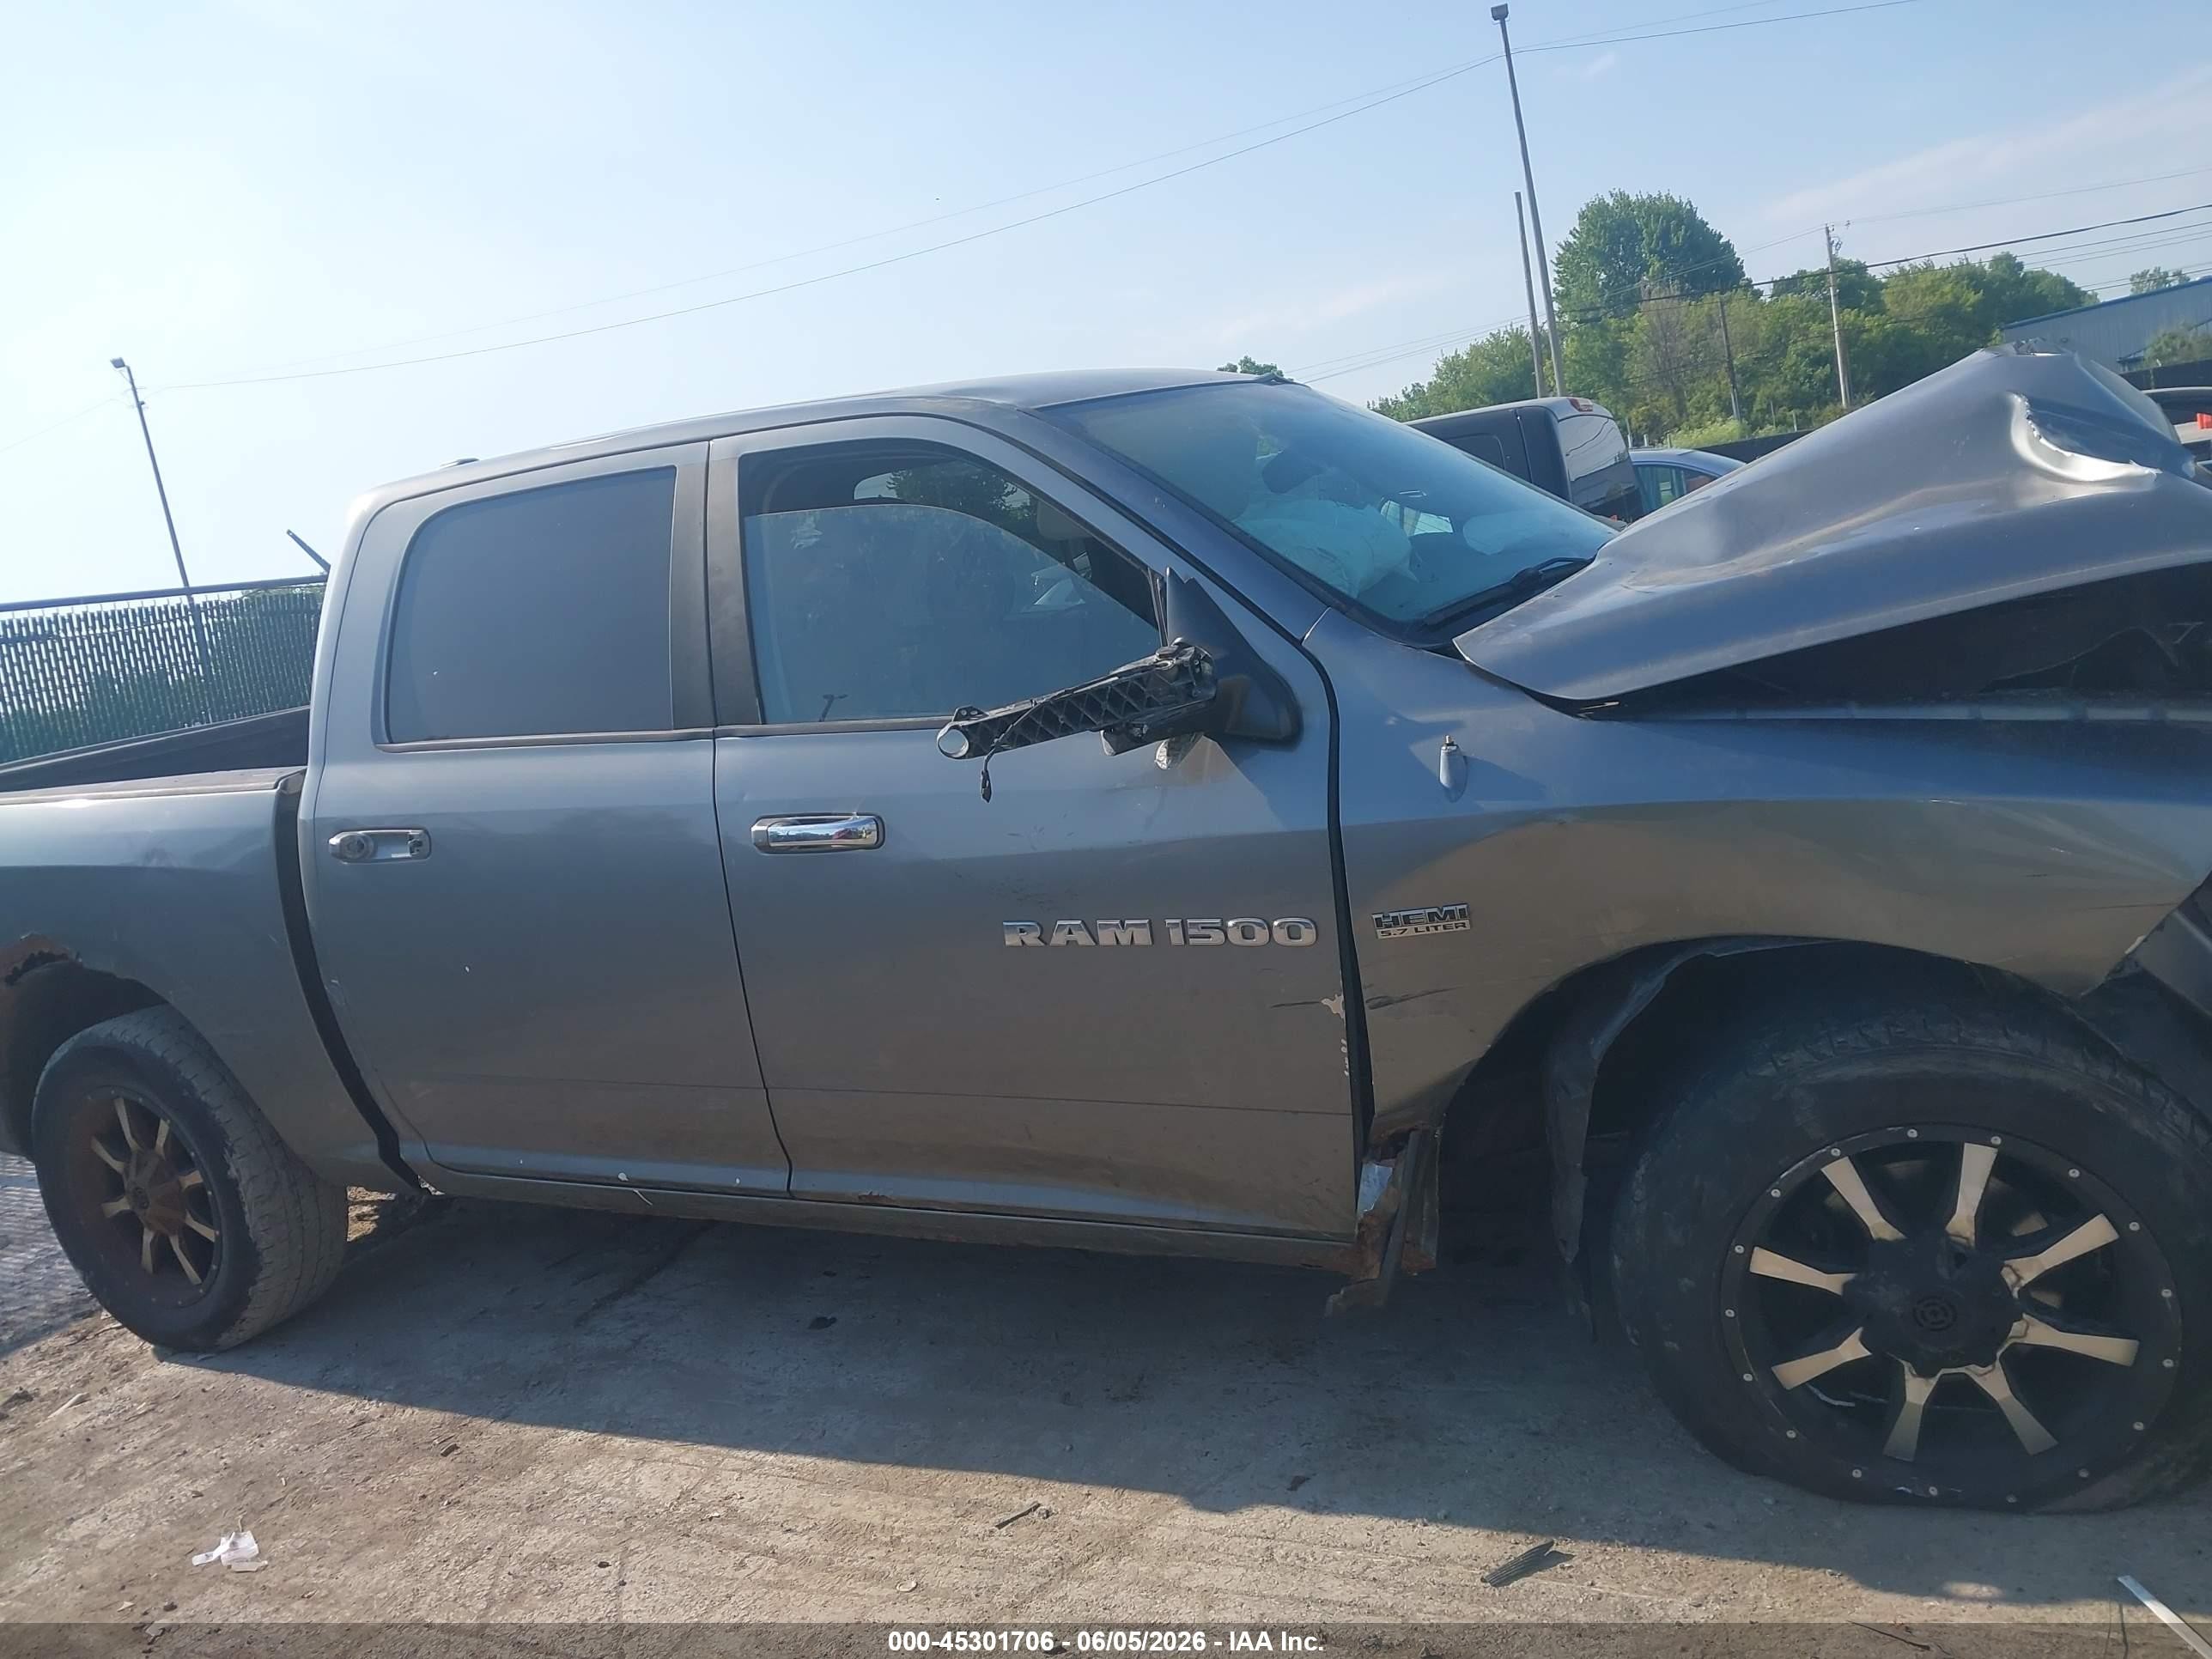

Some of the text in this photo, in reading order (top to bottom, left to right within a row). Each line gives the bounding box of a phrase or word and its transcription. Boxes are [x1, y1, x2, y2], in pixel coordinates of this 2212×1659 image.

[1372, 904, 1469, 929] HEMI
[1002, 917, 1317, 946] RAM 1500
[1380, 921, 1468, 938] 5.7 LITER
